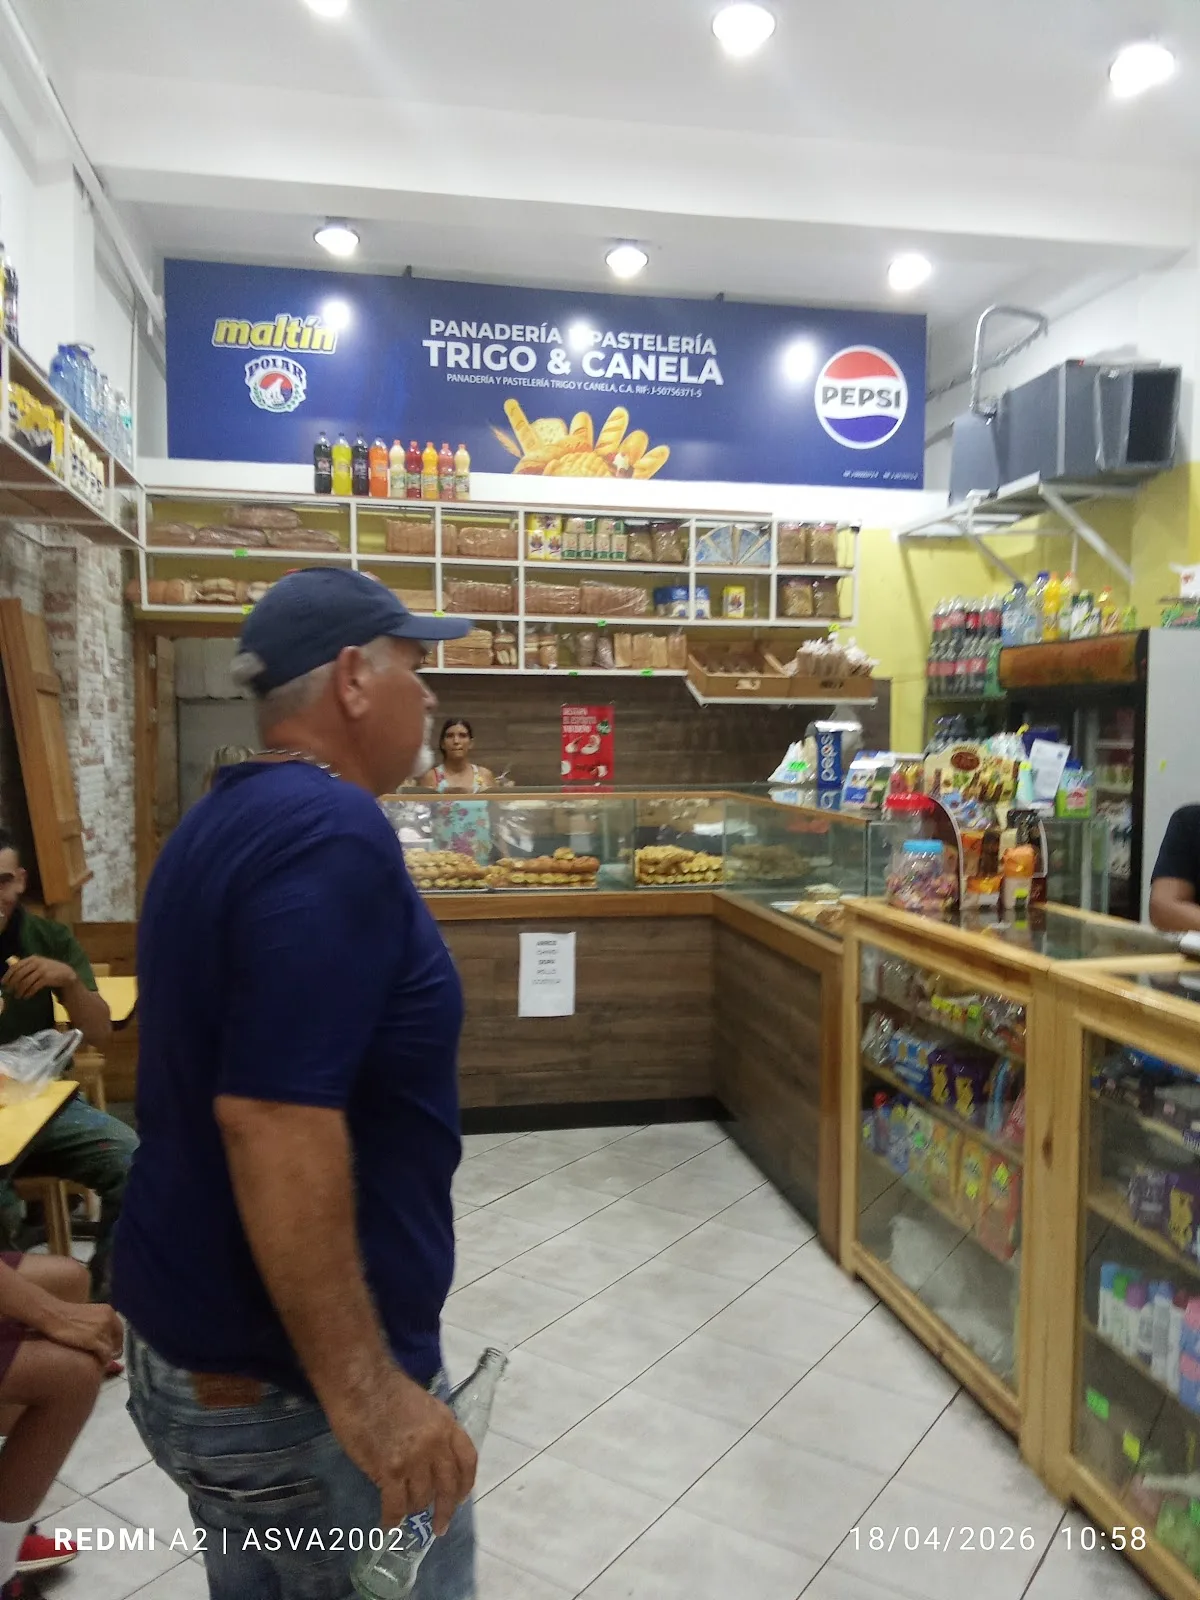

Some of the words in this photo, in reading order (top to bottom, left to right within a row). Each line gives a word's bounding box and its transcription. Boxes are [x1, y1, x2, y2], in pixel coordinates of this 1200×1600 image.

[213, 314, 336, 353] maltín
[429, 318, 563, 344] PANADERÍA
[591, 331, 718, 355] PASTELERÍA
[248, 358, 303, 384] POLAR
[422, 339, 538, 373] TRIGO
[547, 347, 572, 375] &
[582, 351, 724, 386] CANELA
[446, 373, 495, 385] PANADERÍA
[495, 376, 502, 386] Y
[502, 377, 550, 388] PASTELERÍA
[550, 379, 576, 390] TRIGO
[576, 382, 582, 390] Y
[821, 386, 901, 409] PEPSI
[820, 733, 838, 782] peps
